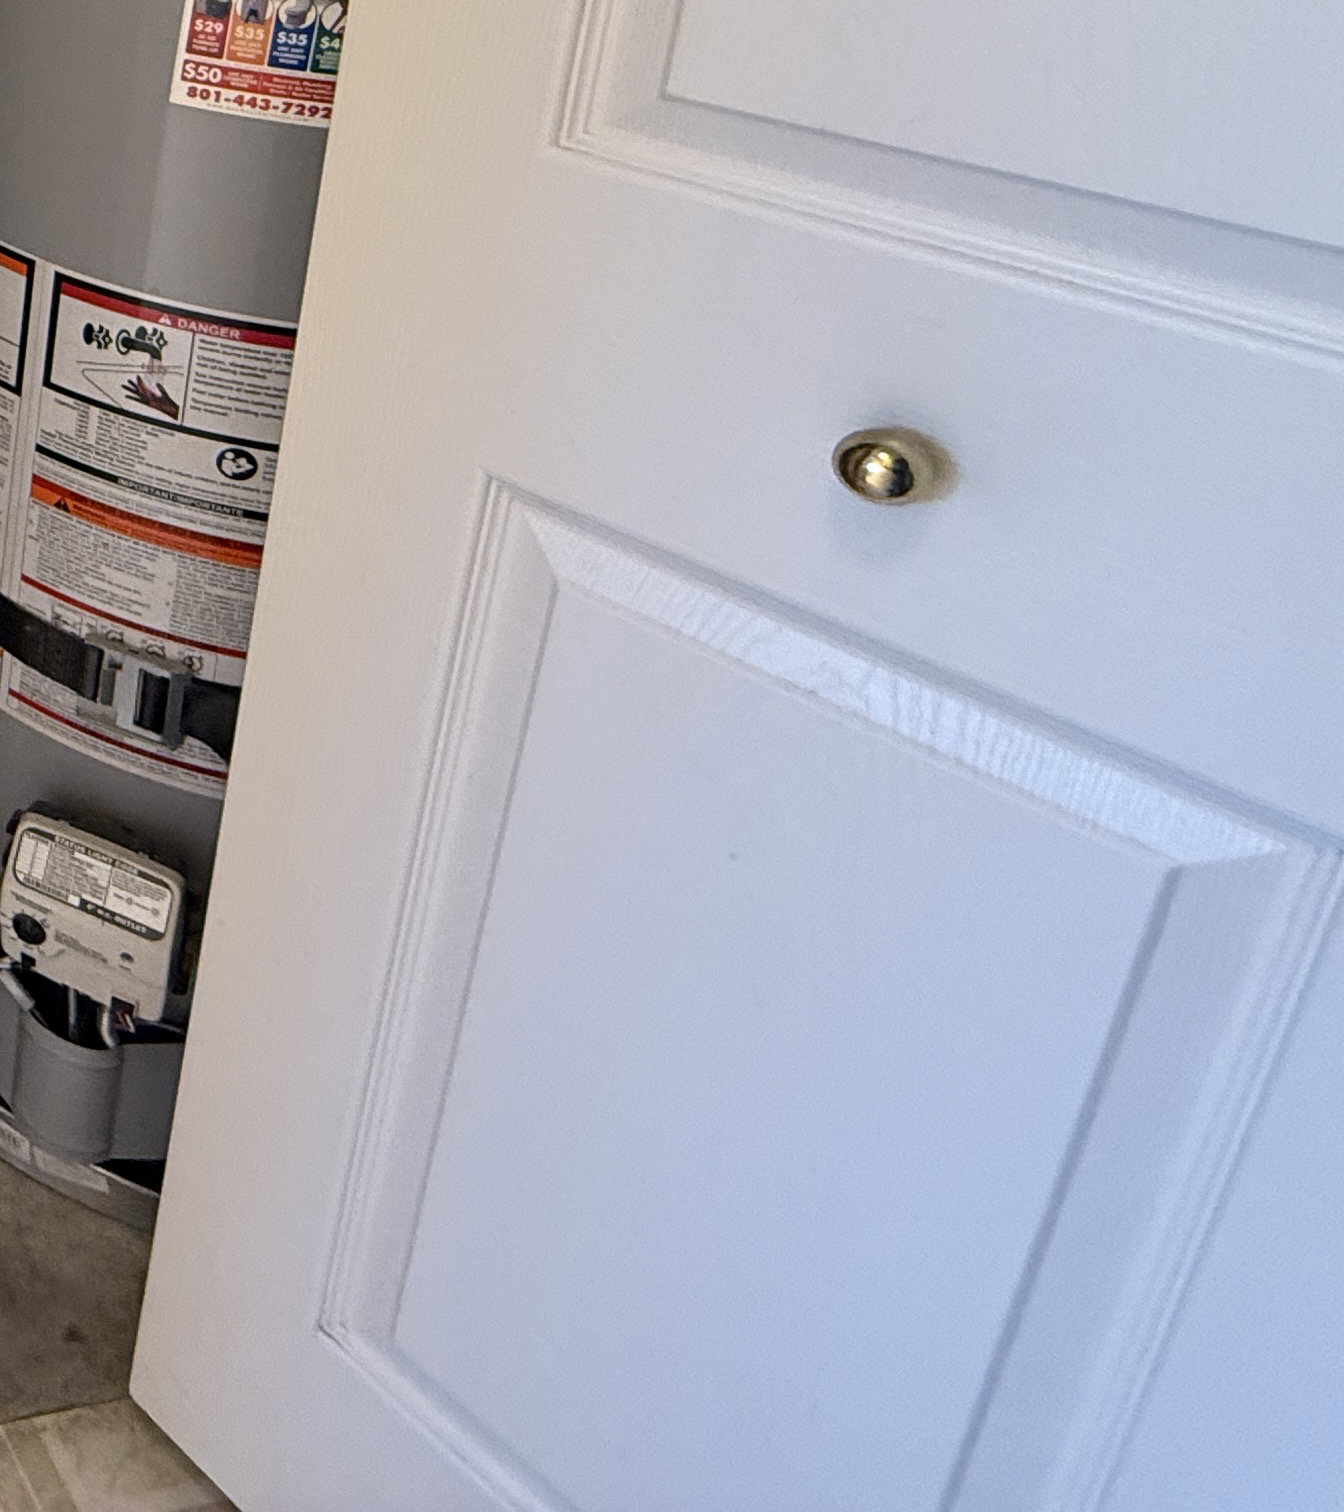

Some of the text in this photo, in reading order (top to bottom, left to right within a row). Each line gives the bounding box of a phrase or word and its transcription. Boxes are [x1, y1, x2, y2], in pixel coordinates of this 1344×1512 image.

[194, 19, 224, 34] $29
[234, 25, 264, 41] $35
[276, 31, 308, 46] $35
[183, 62, 222, 84] $50
[186, 86, 333, 120] 801-443-7292
[178, 317, 241, 340] DANGER
